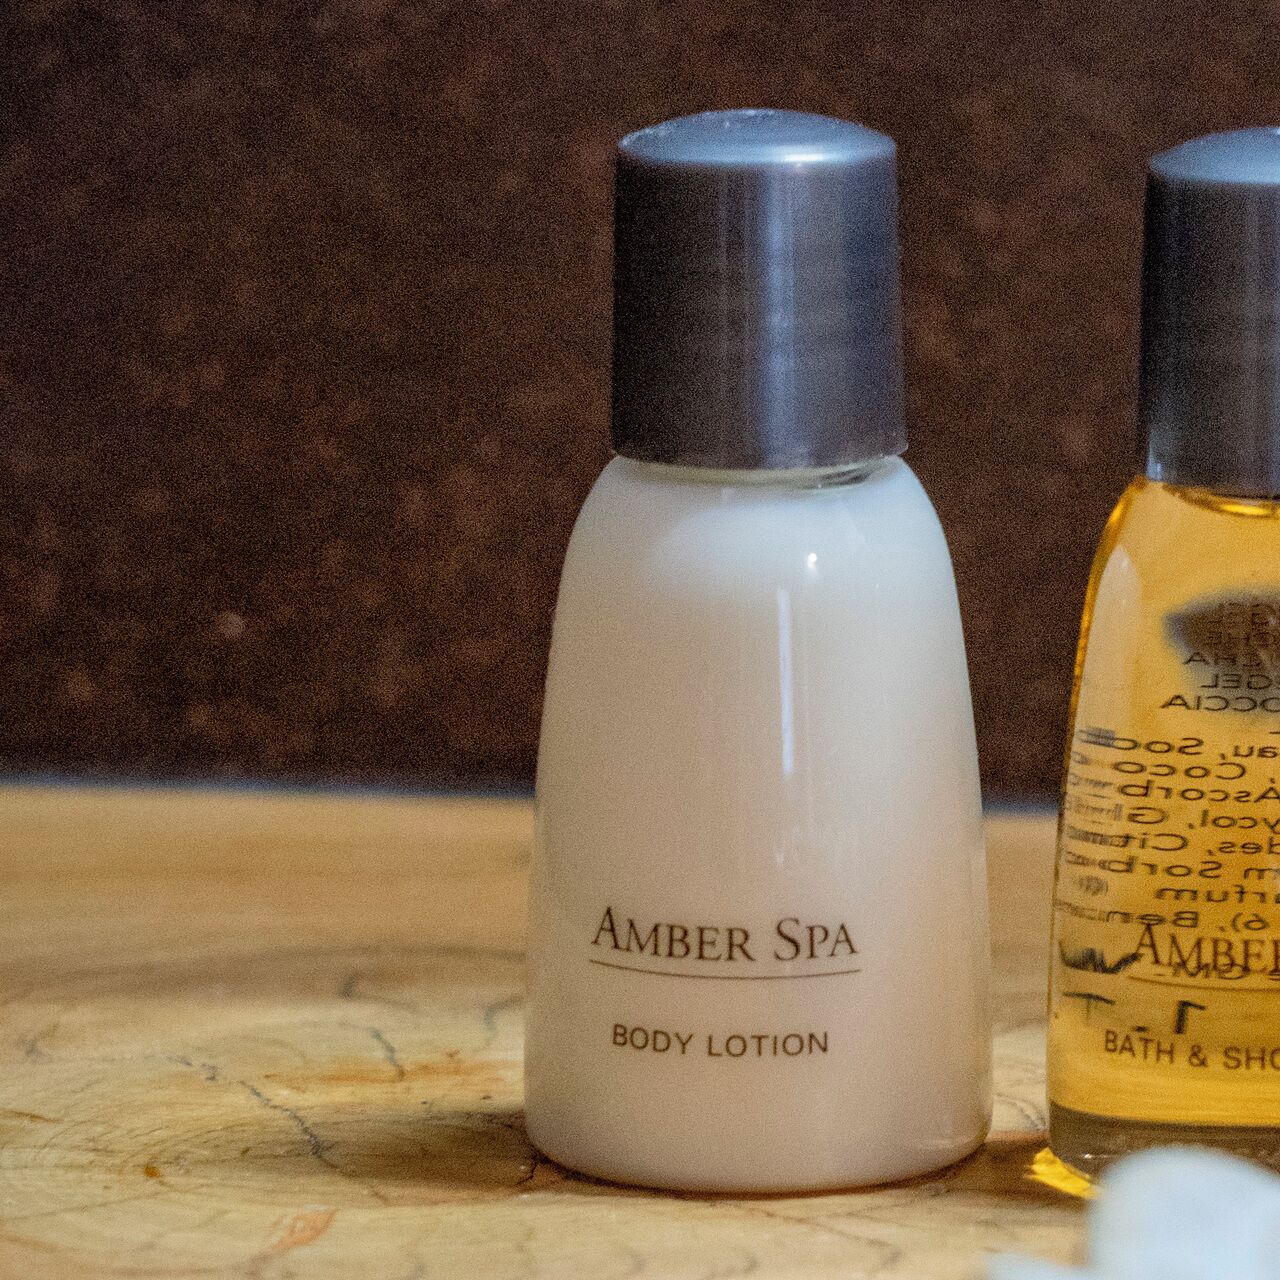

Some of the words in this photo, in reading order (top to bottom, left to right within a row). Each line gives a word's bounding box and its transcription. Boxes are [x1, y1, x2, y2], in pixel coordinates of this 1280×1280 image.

[591, 906, 757, 962] AMBER
[773, 917, 858, 962] SPA
[612, 1023, 693, 1055] BODY
[707, 1031, 828, 1057] LOTION
[1104, 1030, 1175, 1064] BATH
[1188, 1044, 1208, 1068] &
